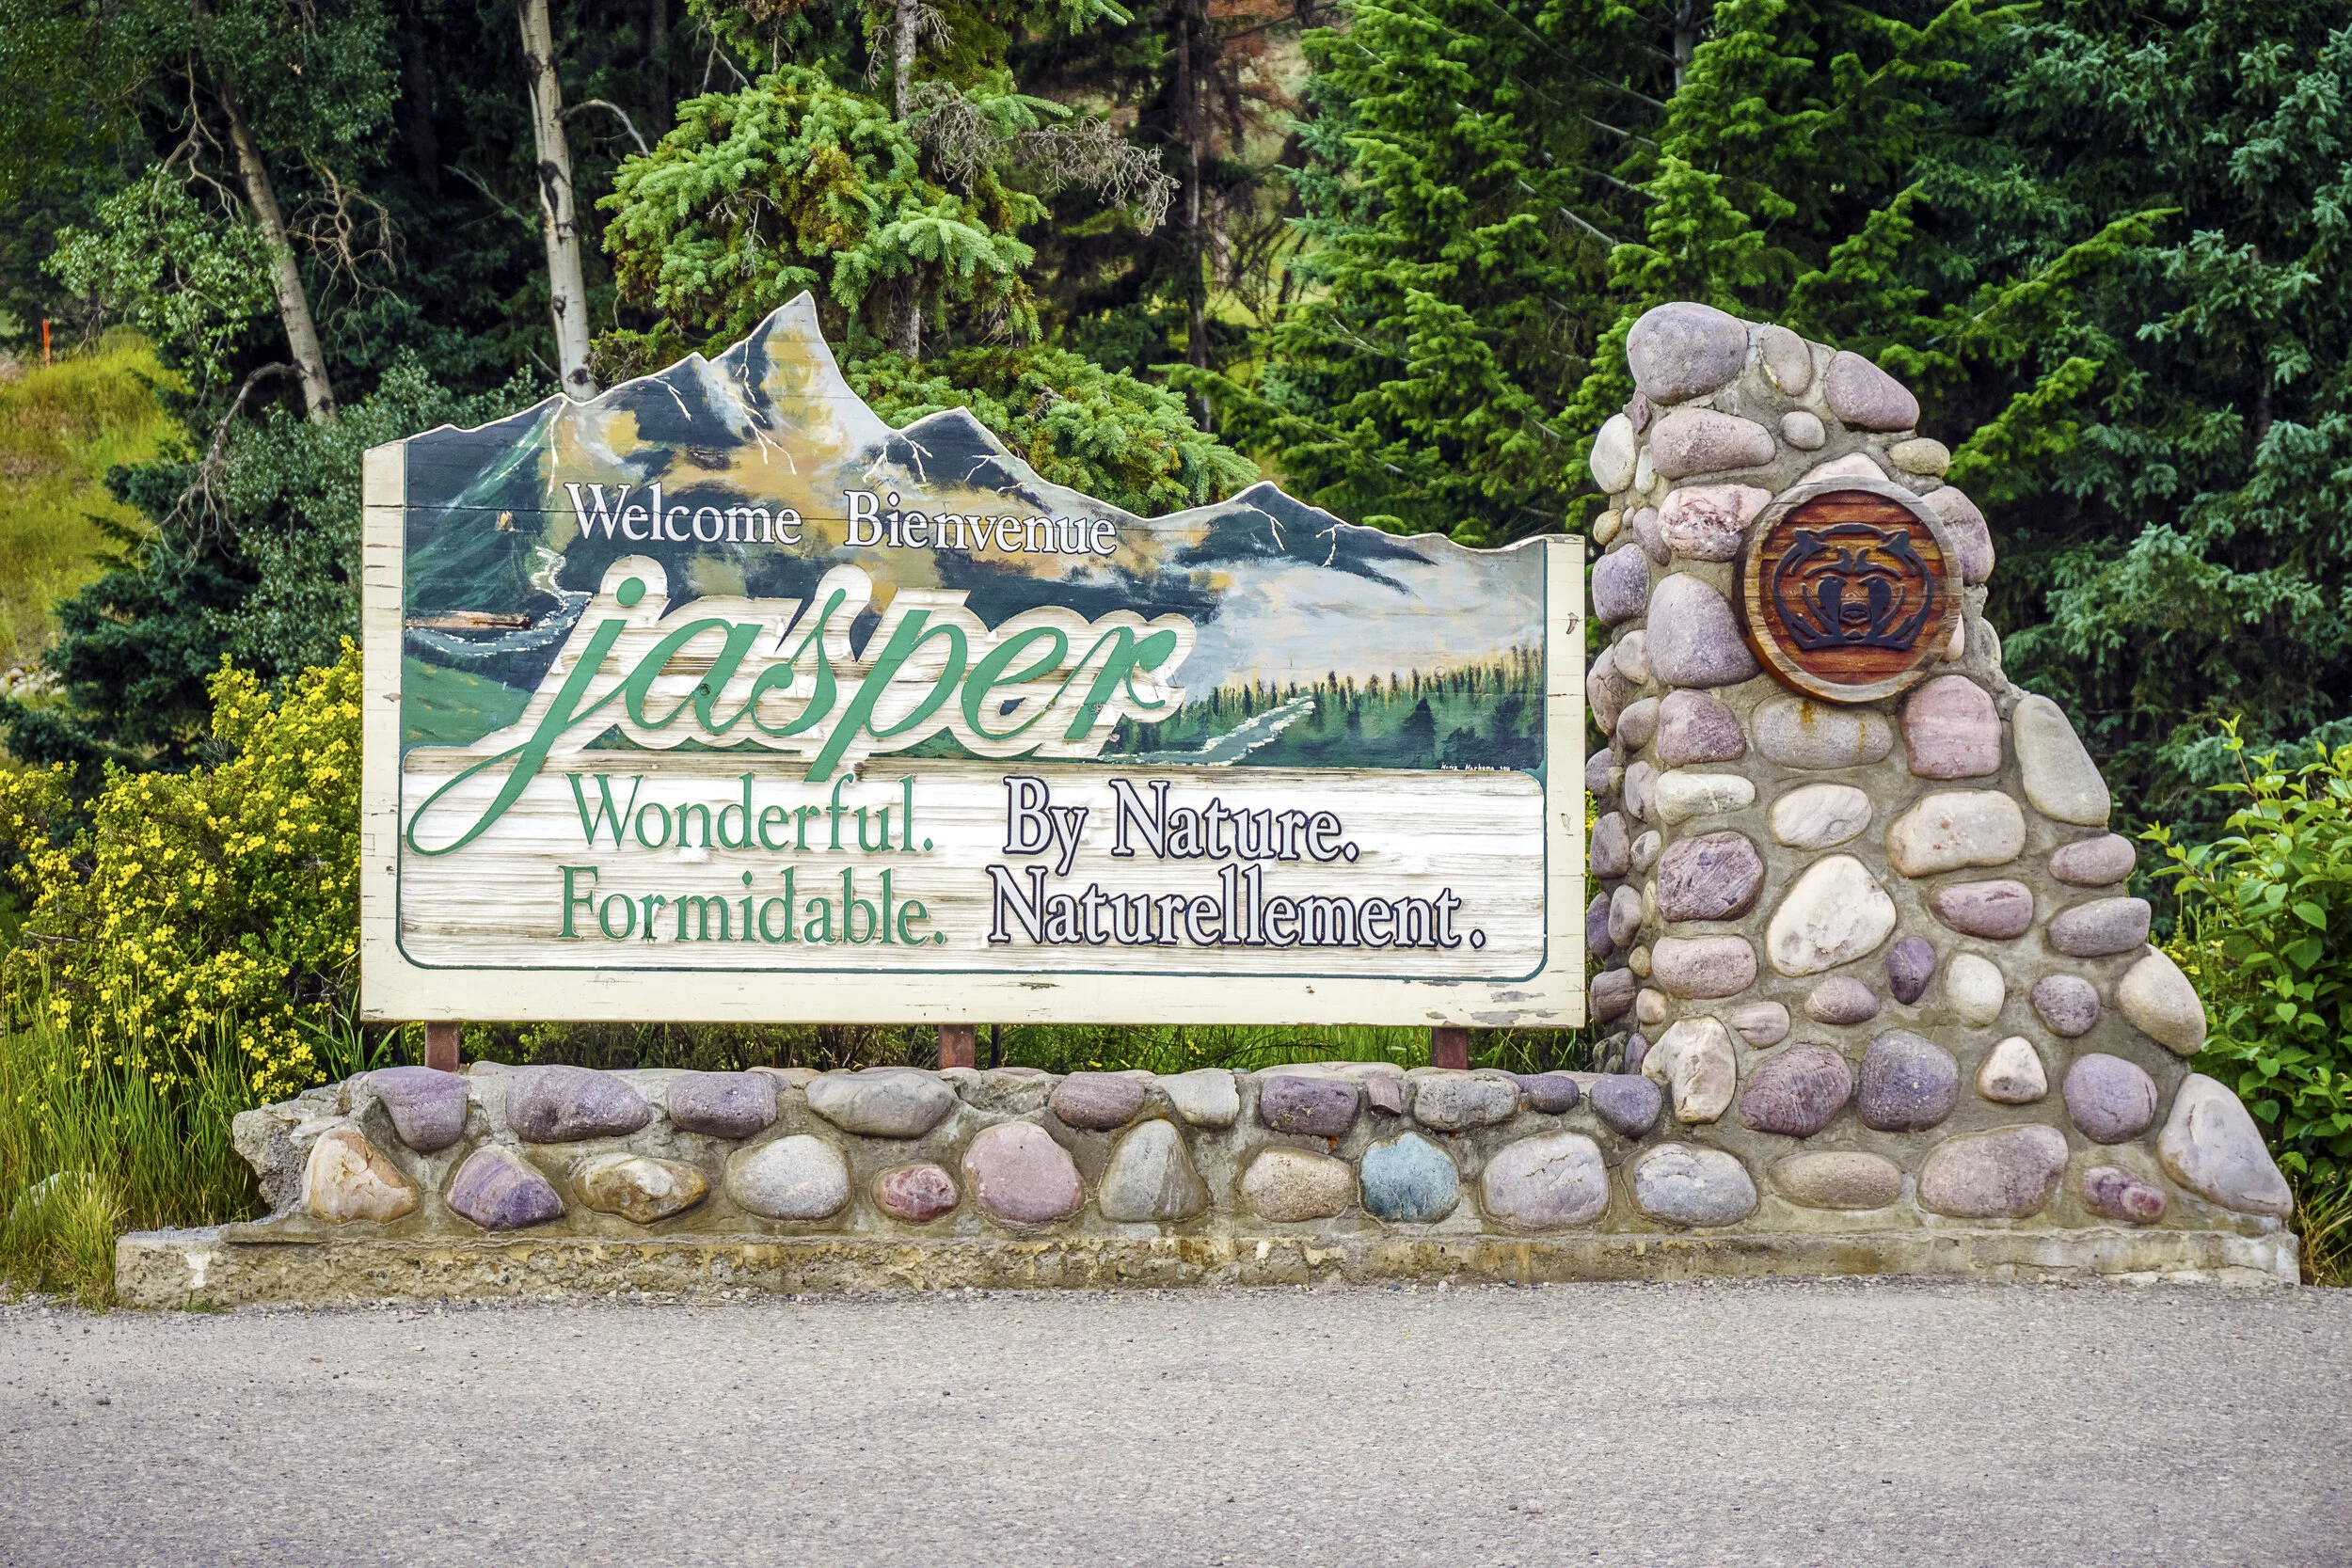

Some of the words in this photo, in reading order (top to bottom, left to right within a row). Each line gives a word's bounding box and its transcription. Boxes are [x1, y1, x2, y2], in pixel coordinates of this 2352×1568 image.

[564, 482, 803, 545] Welcome
[843, 489, 1118, 554] Bienvenue
[406, 577, 1176, 855] jasper
[564, 771, 934, 851] Wonderful.
[1002, 776, 1089, 876] By
[1108, 778, 1361, 863] Nature.
[558, 864, 946, 945] Formidable.
[985, 863, 1486, 950] Naturellement.
